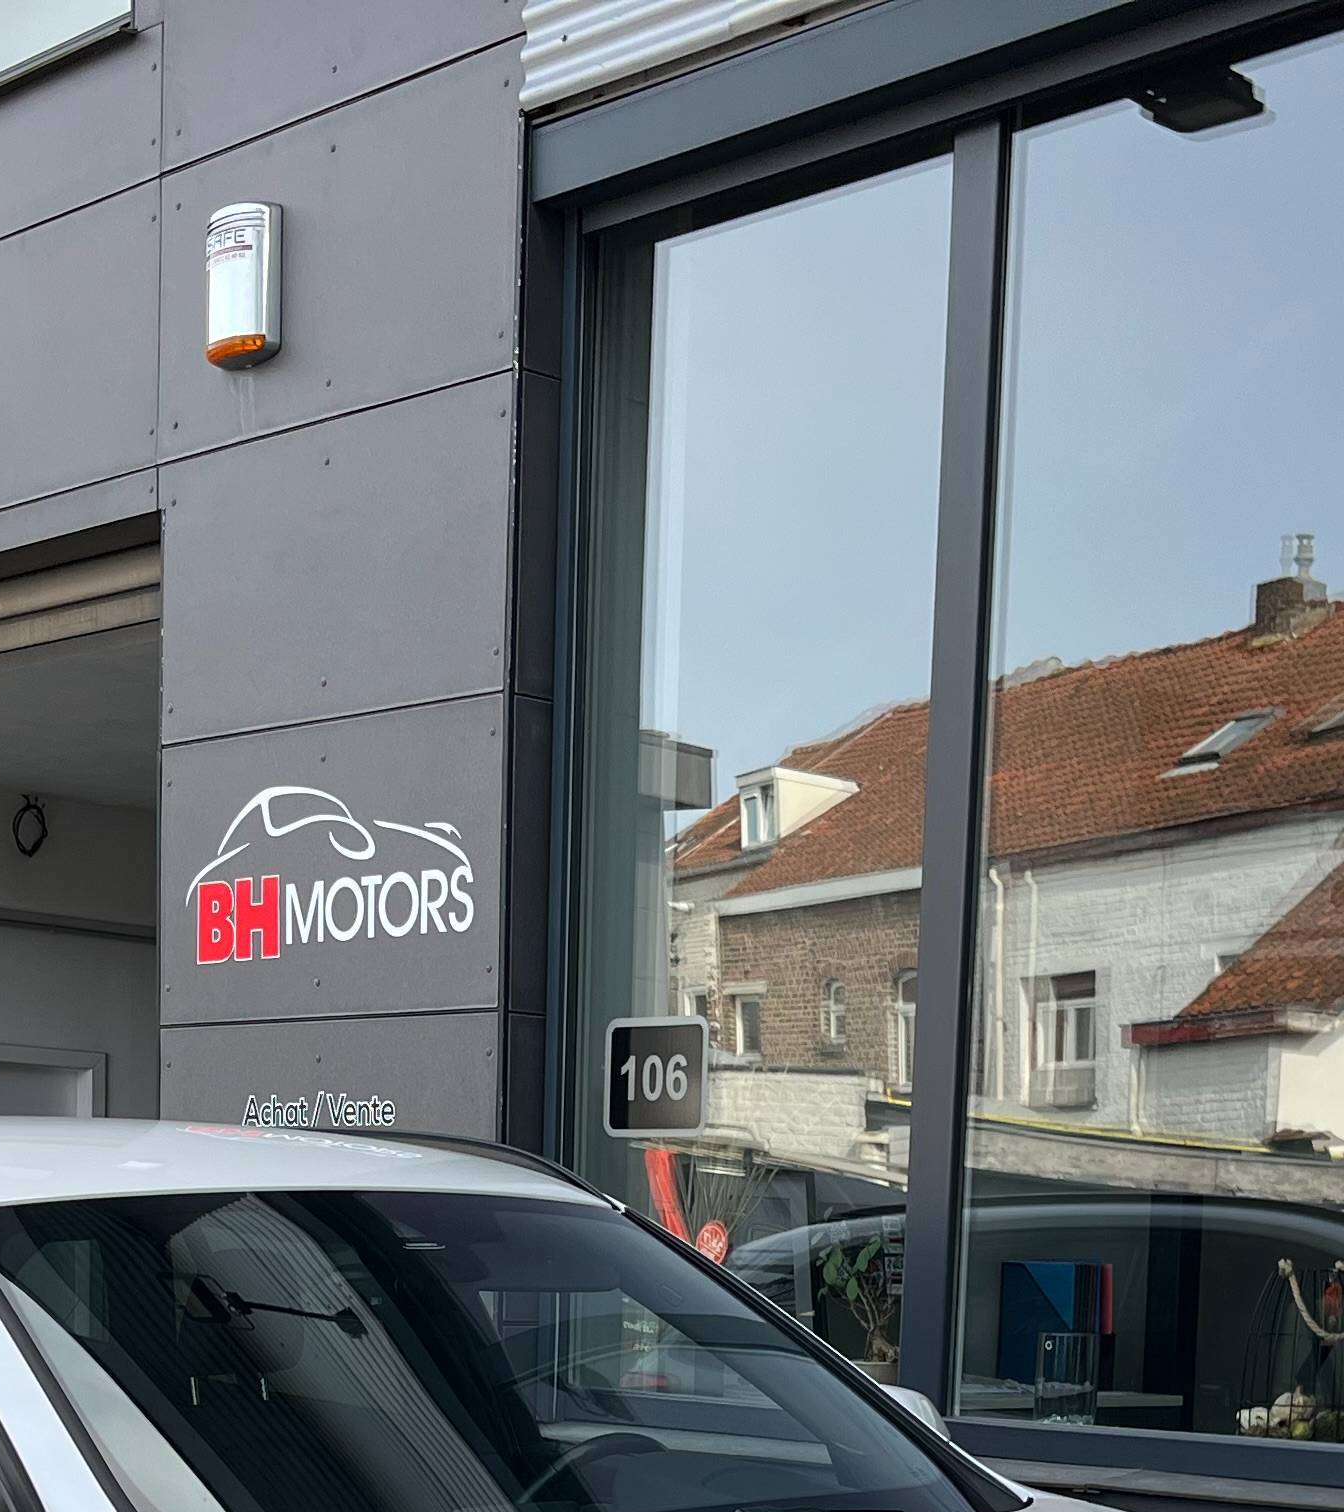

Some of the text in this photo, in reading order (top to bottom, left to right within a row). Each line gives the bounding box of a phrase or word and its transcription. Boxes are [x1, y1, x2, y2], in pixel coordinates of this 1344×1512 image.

[196, 866, 475, 965] BH MOTORS
[620, 1054, 688, 1103] 106
[242, 1091, 396, 1128] Achat / Vente
